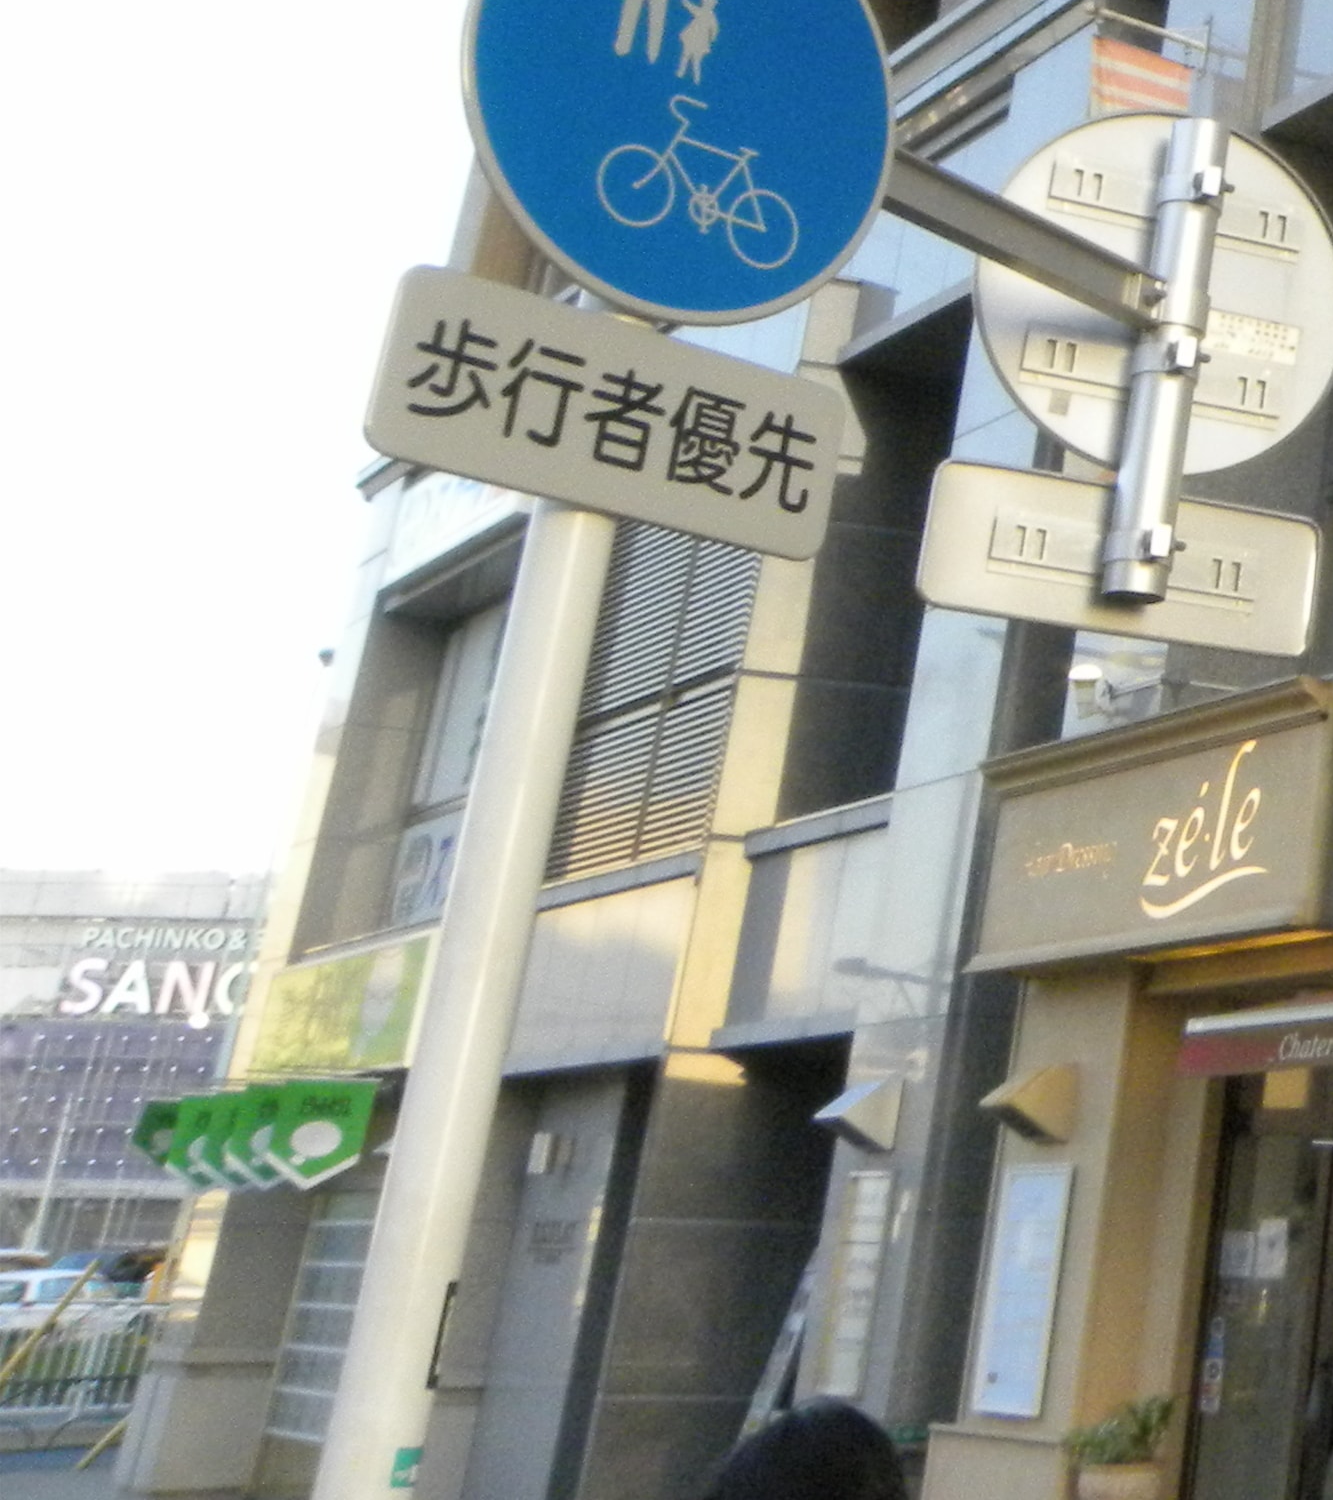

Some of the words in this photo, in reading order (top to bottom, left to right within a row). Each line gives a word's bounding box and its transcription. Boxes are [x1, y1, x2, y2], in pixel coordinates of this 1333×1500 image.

[406, 317, 820, 514] 歩行者優先
